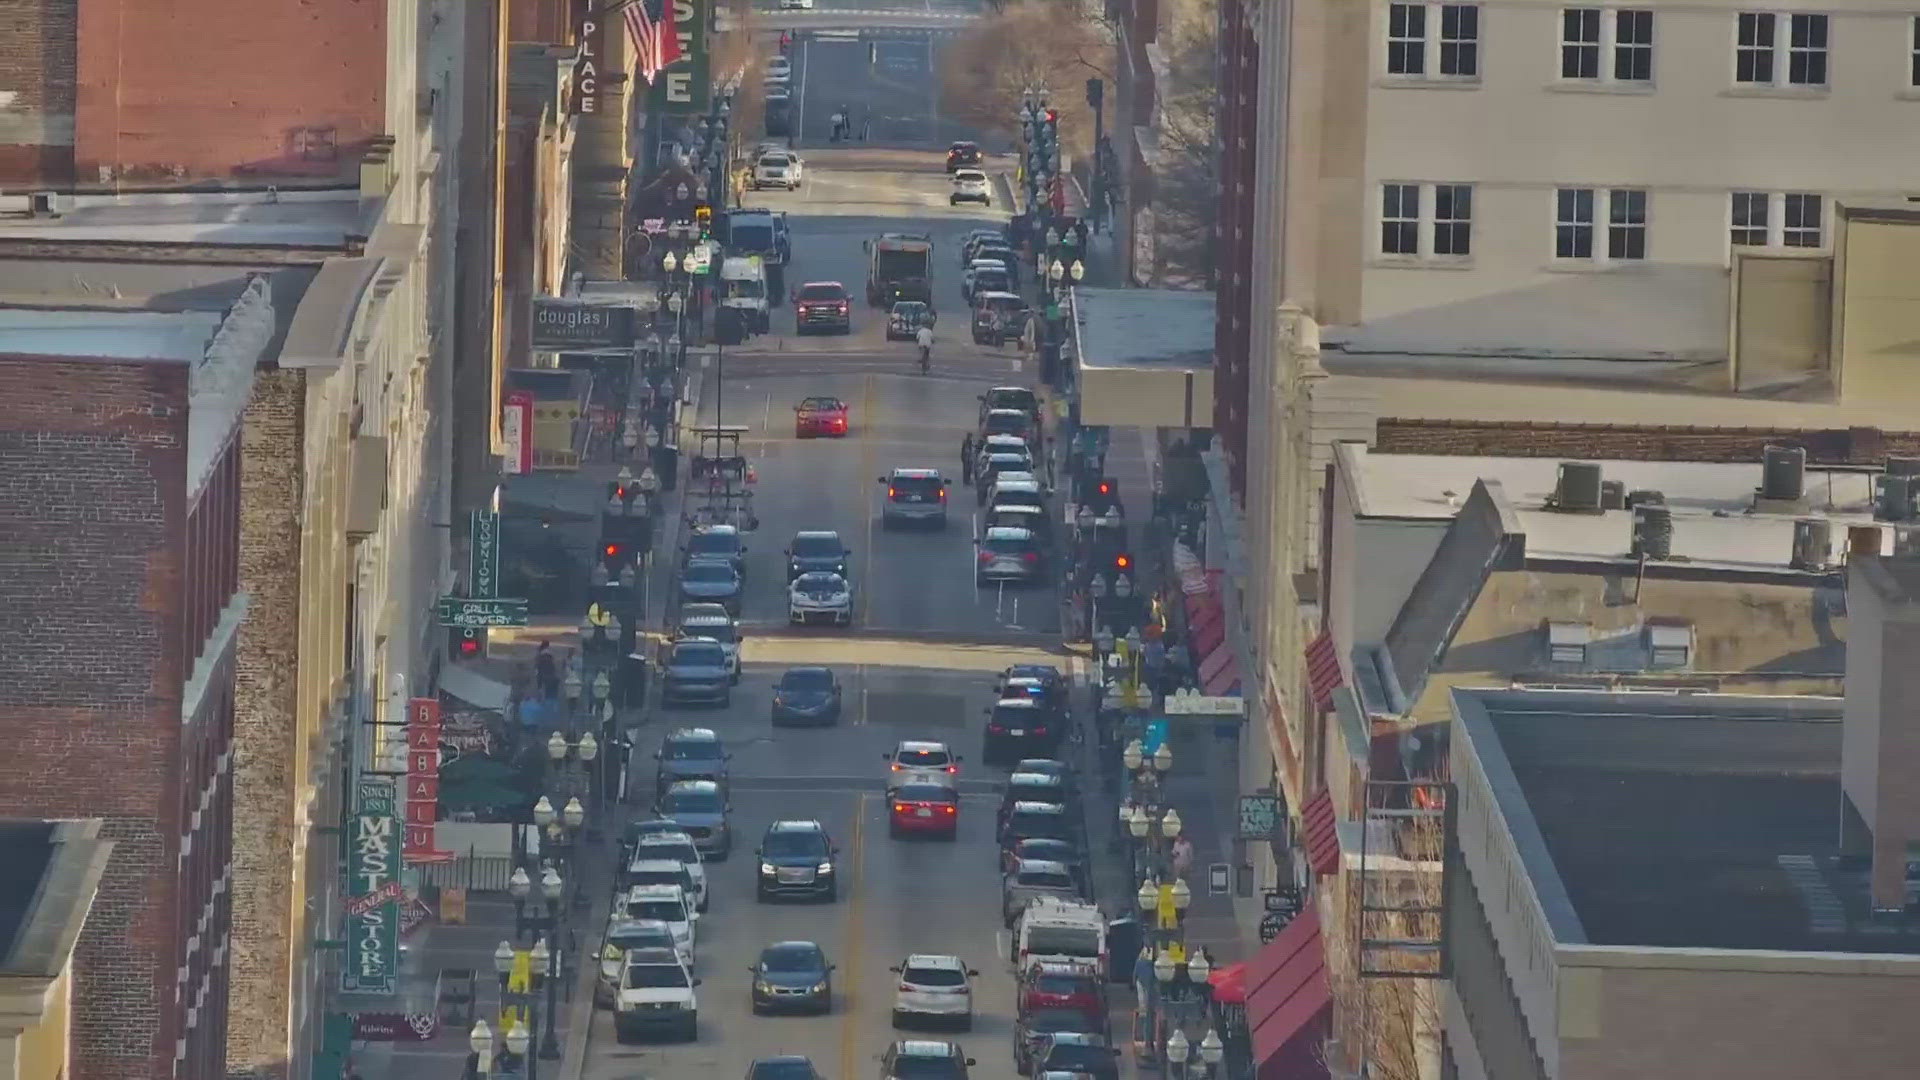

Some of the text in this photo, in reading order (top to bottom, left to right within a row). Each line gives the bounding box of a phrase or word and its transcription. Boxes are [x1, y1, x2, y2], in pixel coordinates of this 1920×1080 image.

[581, 22, 596, 112] PLACE
[538, 308, 600, 328] douglas
[478, 520, 491, 595] DOWNTOWN
[462, 603, 492, 615] GRILL
[414, 705, 429, 846] BABALU
[356, 816, 392, 891] MAST
[351, 885, 398, 915] GENERAL
[360, 909, 386, 977] STORE
